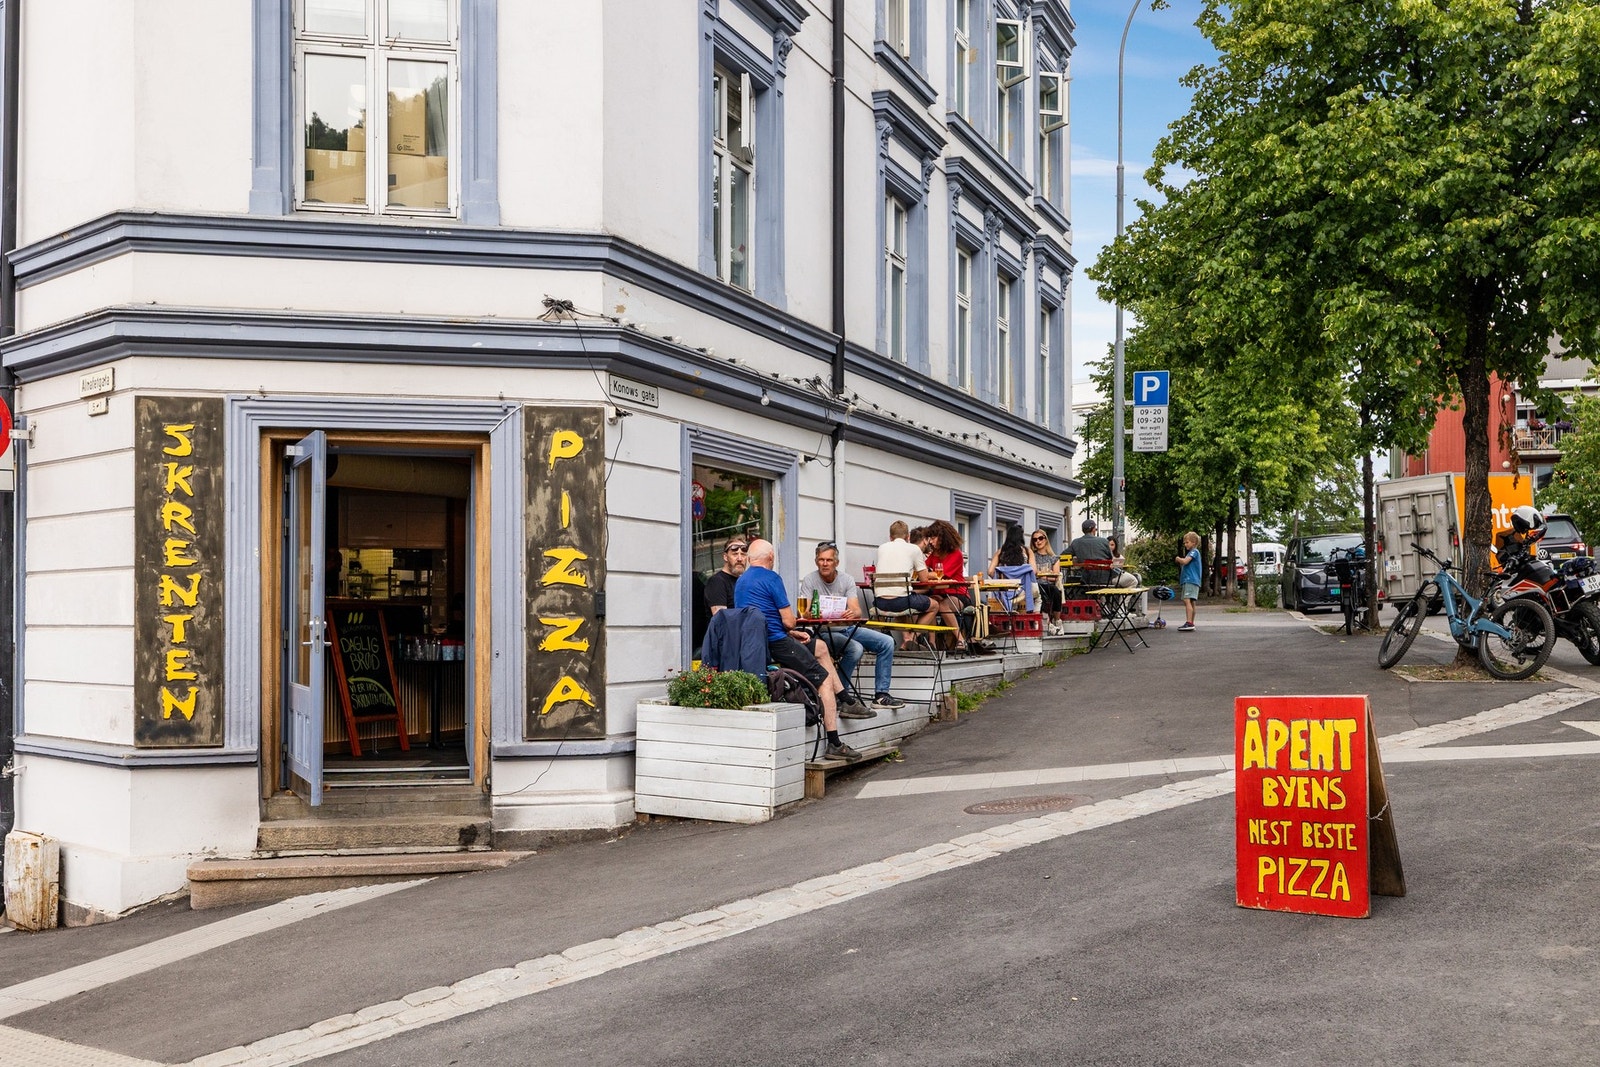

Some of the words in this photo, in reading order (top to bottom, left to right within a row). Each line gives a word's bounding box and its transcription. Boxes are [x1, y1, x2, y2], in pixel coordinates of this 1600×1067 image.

[613, 380, 639, 398] Konows
[641, 390, 655, 402] gate
[1142, 376, 1160, 402] P
[158, 423, 202, 721] SKRENTEN
[537, 429, 595, 715] PIZZA
[340, 636, 380, 653] DAGLIG
[1242, 706, 1358, 772] ÅPENT
[1262, 775, 1347, 811] BYENS
[1248, 818, 1293, 846] NEST
[1301, 820, 1358, 851] BESTE
[1257, 855, 1351, 902] PIZZA
